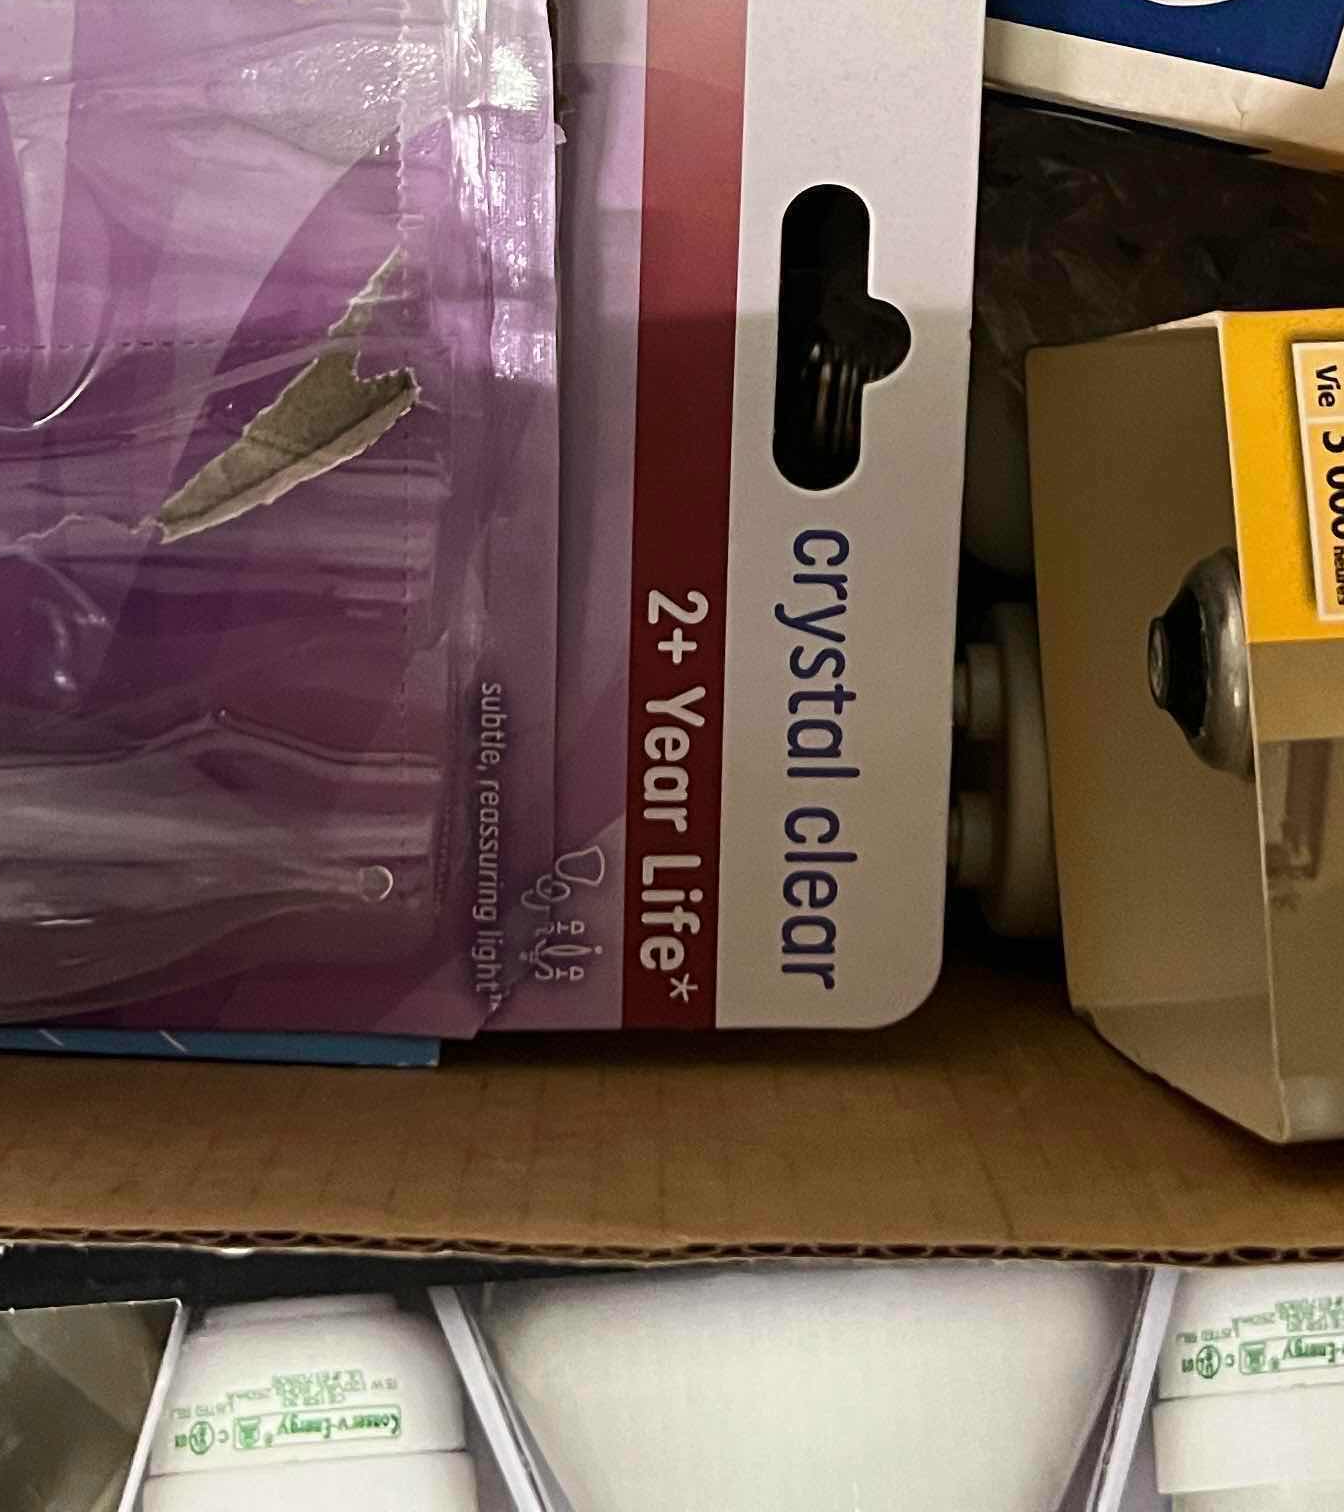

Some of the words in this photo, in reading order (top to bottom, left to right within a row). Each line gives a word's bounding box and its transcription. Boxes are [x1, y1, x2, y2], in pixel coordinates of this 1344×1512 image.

[1316, 364, 1337, 409] Vie
[647, 590, 709, 665] 2+
[773, 528, 861, 780] crystal
[477, 681, 509, 773] subtle,
[644, 687, 707, 833] Year
[473, 778, 500, 924] reassuring
[781, 805, 859, 990] clear
